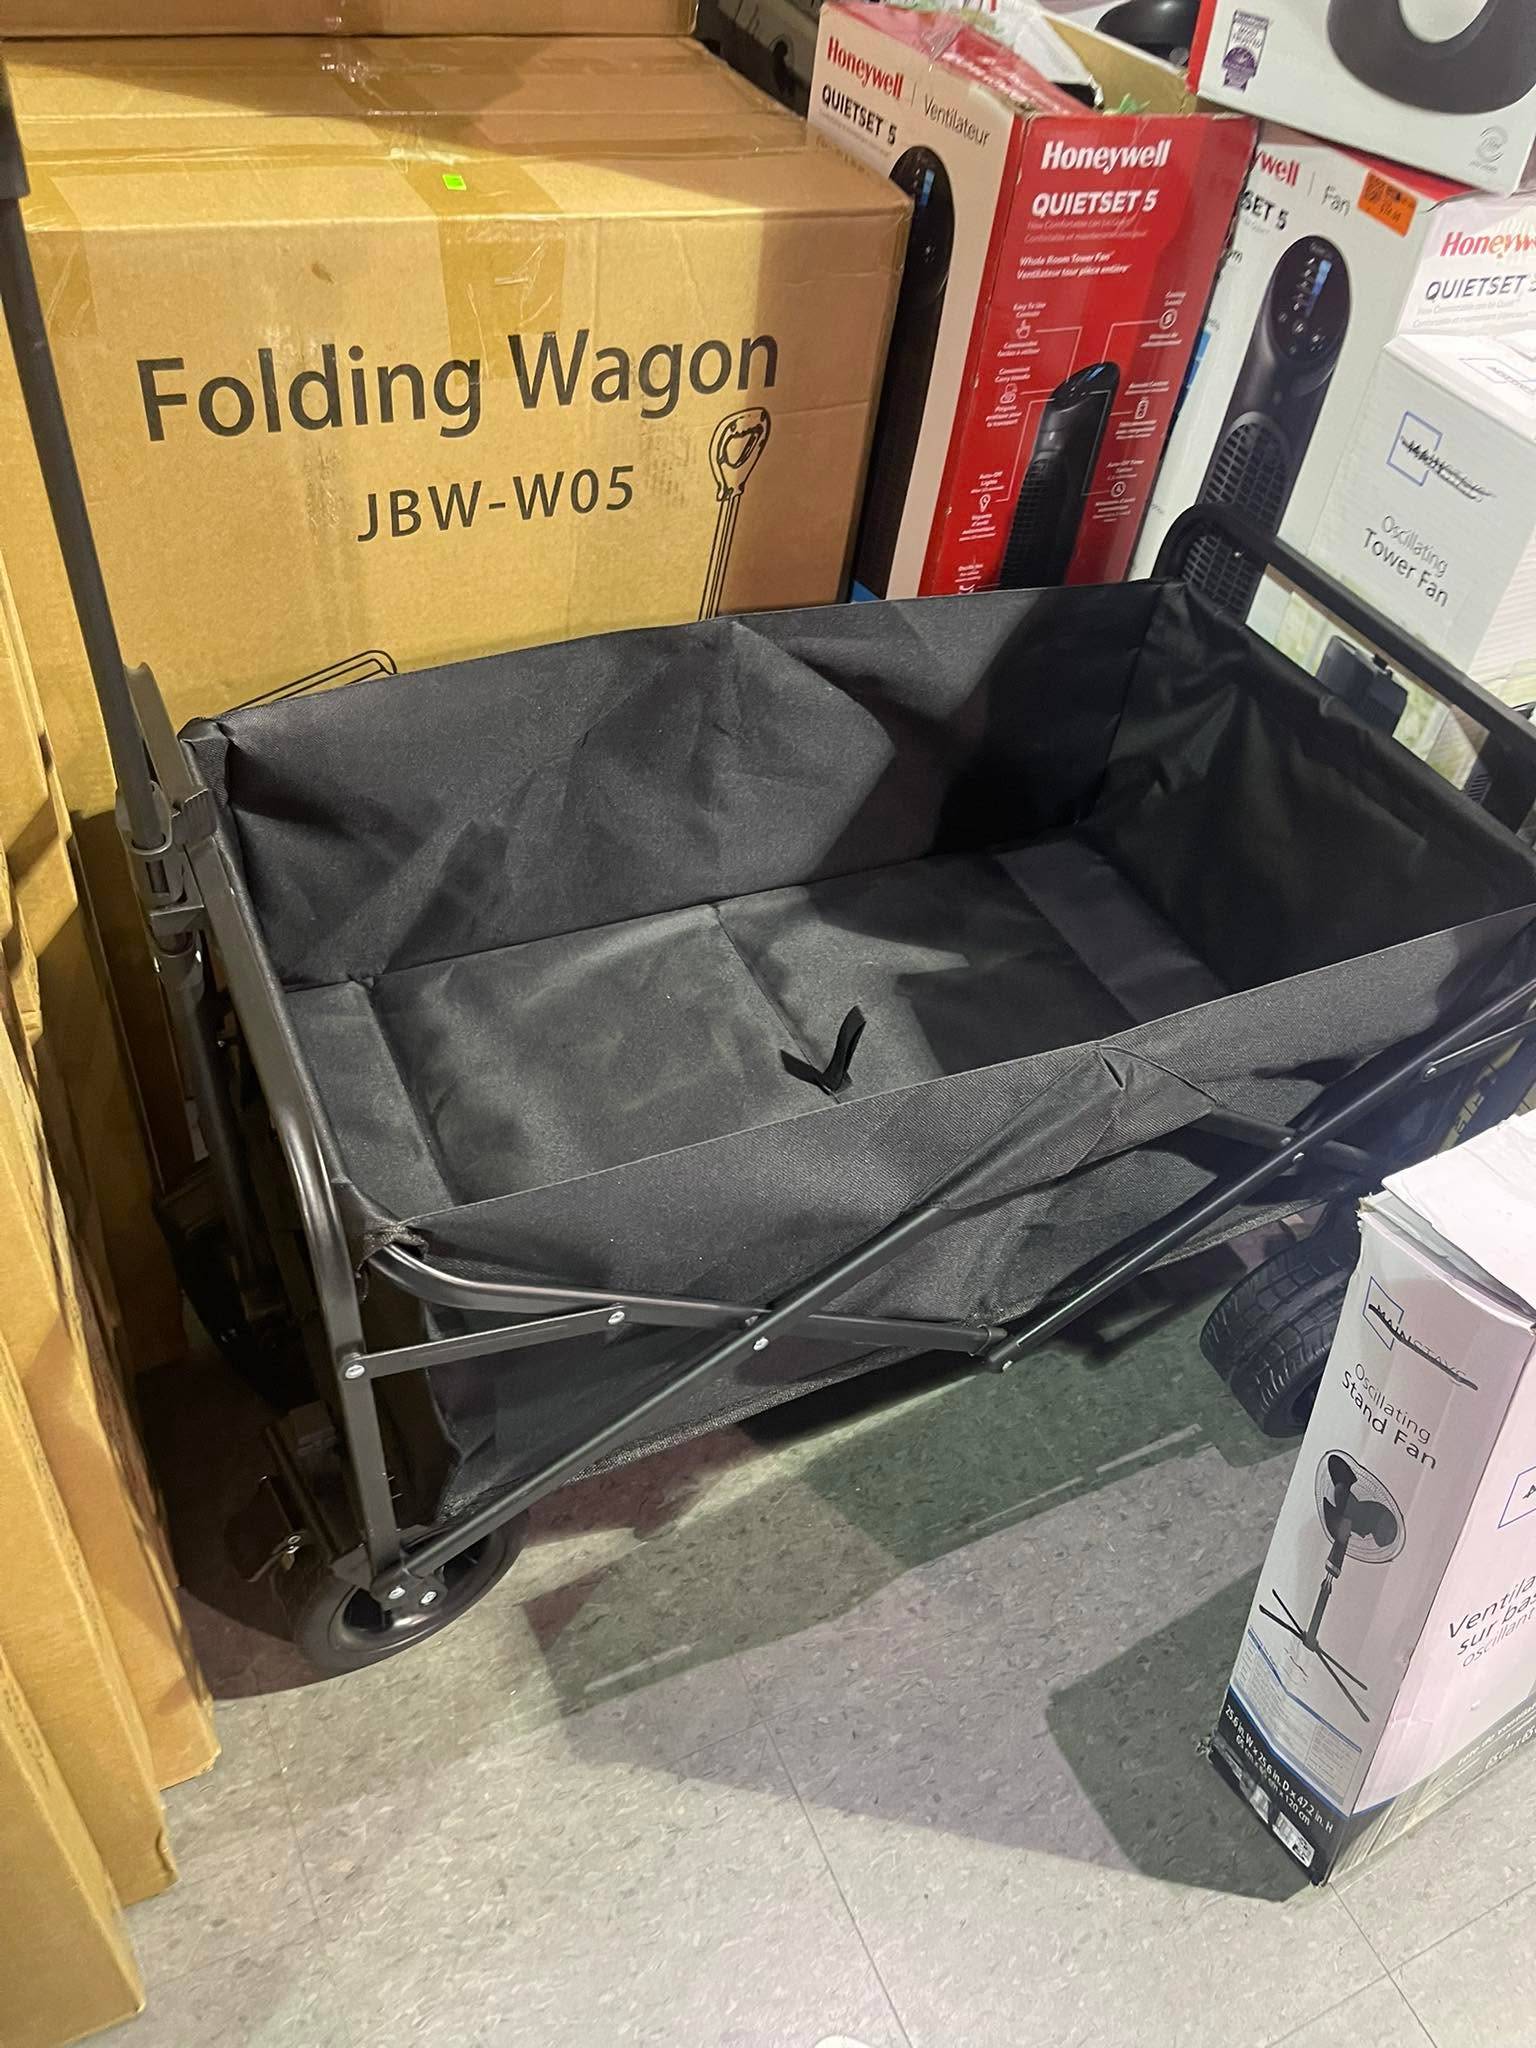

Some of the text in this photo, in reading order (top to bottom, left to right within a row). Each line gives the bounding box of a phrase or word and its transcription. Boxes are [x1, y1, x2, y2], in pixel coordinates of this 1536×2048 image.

[827, 36, 905, 100] Honeywell
[822, 84, 899, 146] QUIETSET 5
[924, 93, 992, 147] Ventilateur
[1040, 138, 1173, 176] Honeywell
[1031, 189, 1160, 219] QUIETSET 5
[1275, 210, 1290, 231] 5
[1320, 183, 1351, 217] Fan
[1017, 267, 1061, 281] Ventilateur
[1019, 255, 1046, 267] Whole
[1046, 254, 1072, 266] Room
[1071, 253, 1095, 264] Tower
[1426, 274, 1528, 303] QUIETSET
[136, 328, 779, 439] Folding Wagon
[357, 465, 634, 542] JBW-W05
[1363, 527, 1450, 608] Tower Fan
[1381, 514, 1449, 580] Oscillating
[1341, 1370, 1438, 1470] Stand Fan
[1355, 1363, 1432, 1445] Oscillating
[1457, 1620, 1498, 1656] sur
[1225, 1704, 1239, 1728] 25.6
[1246, 1732, 1255, 1748] W
[1258, 1751, 1273, 1775] 25.6
[1282, 1779, 1290, 1791] D
[1297, 1796, 1315, 1816] 47.2
[1325, 1820, 1334, 1834] H
[1285, 1794, 1299, 1813] 120
[1298, 1810, 1310, 1826] cm
